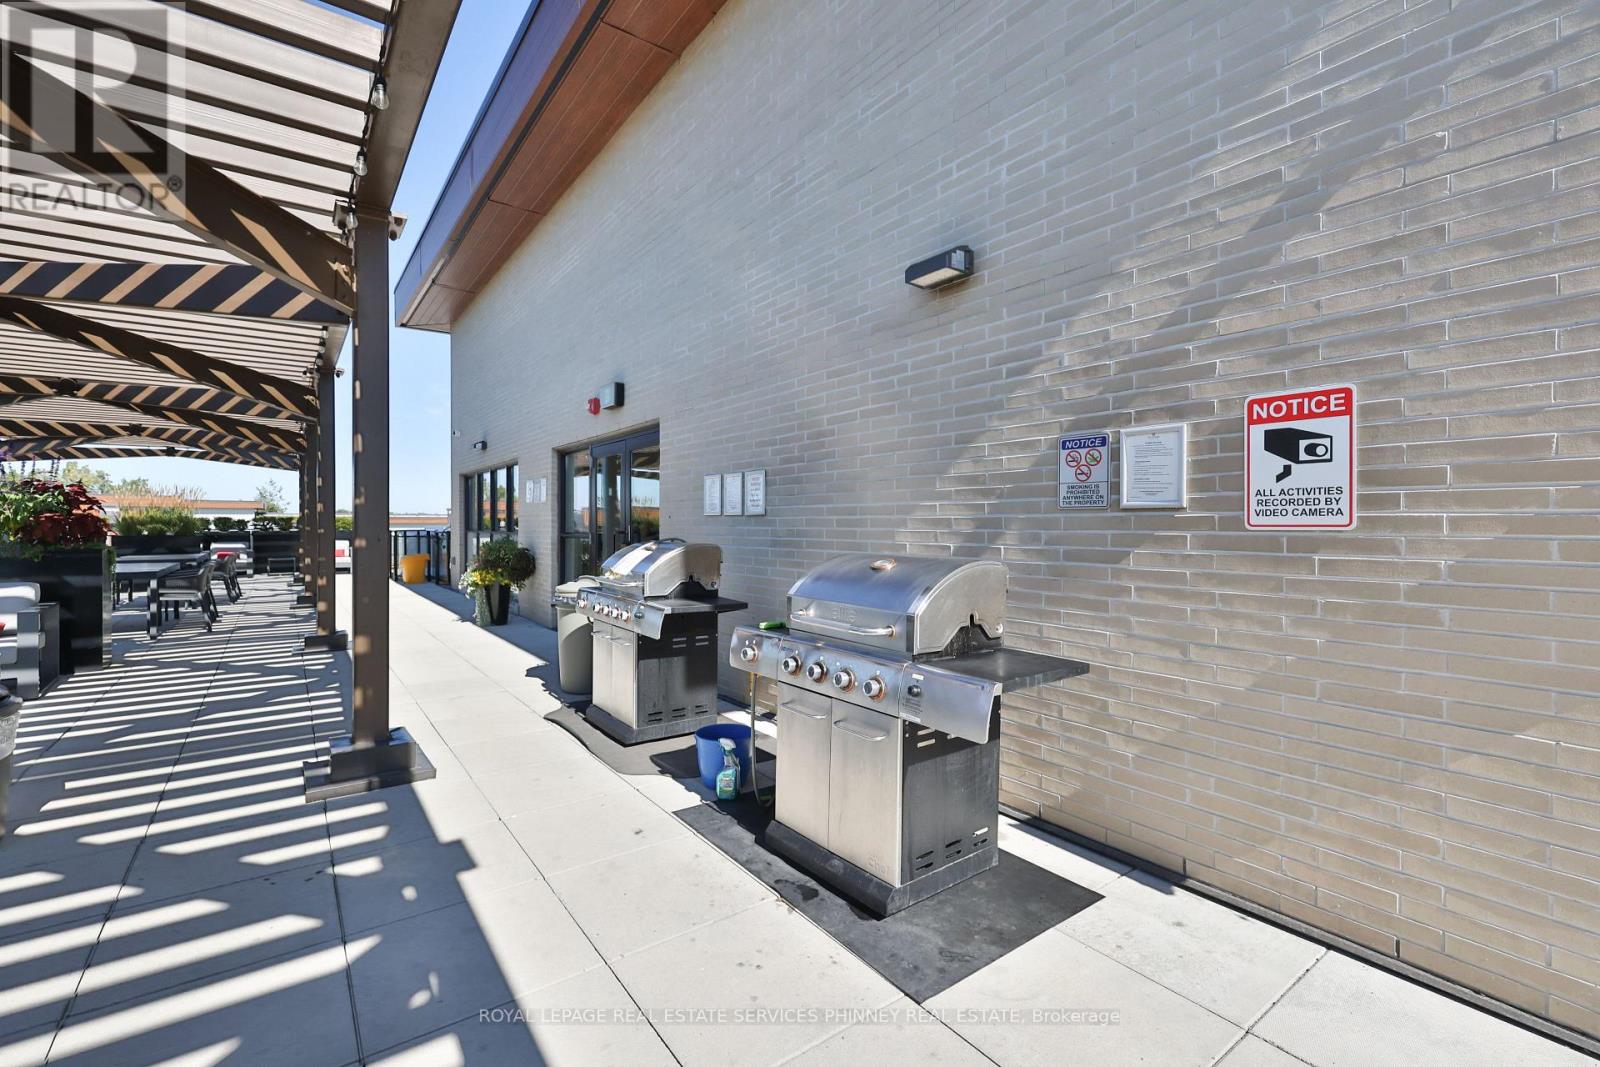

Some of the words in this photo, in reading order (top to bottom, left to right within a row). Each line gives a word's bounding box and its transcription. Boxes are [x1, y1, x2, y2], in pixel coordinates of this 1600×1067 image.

[1252, 392, 1346, 420] NOTICE
[1065, 437, 1103, 449] NOTICE
[1255, 488, 1276, 497] ALL
[1278, 486, 1344, 496] ACTIVITIES
[1256, 497, 1321, 507] RECORDED
[1324, 497, 1342, 506] BY
[1254, 508, 1289, 517] VIDEO
[1291, 507, 1344, 517] CAMERA
